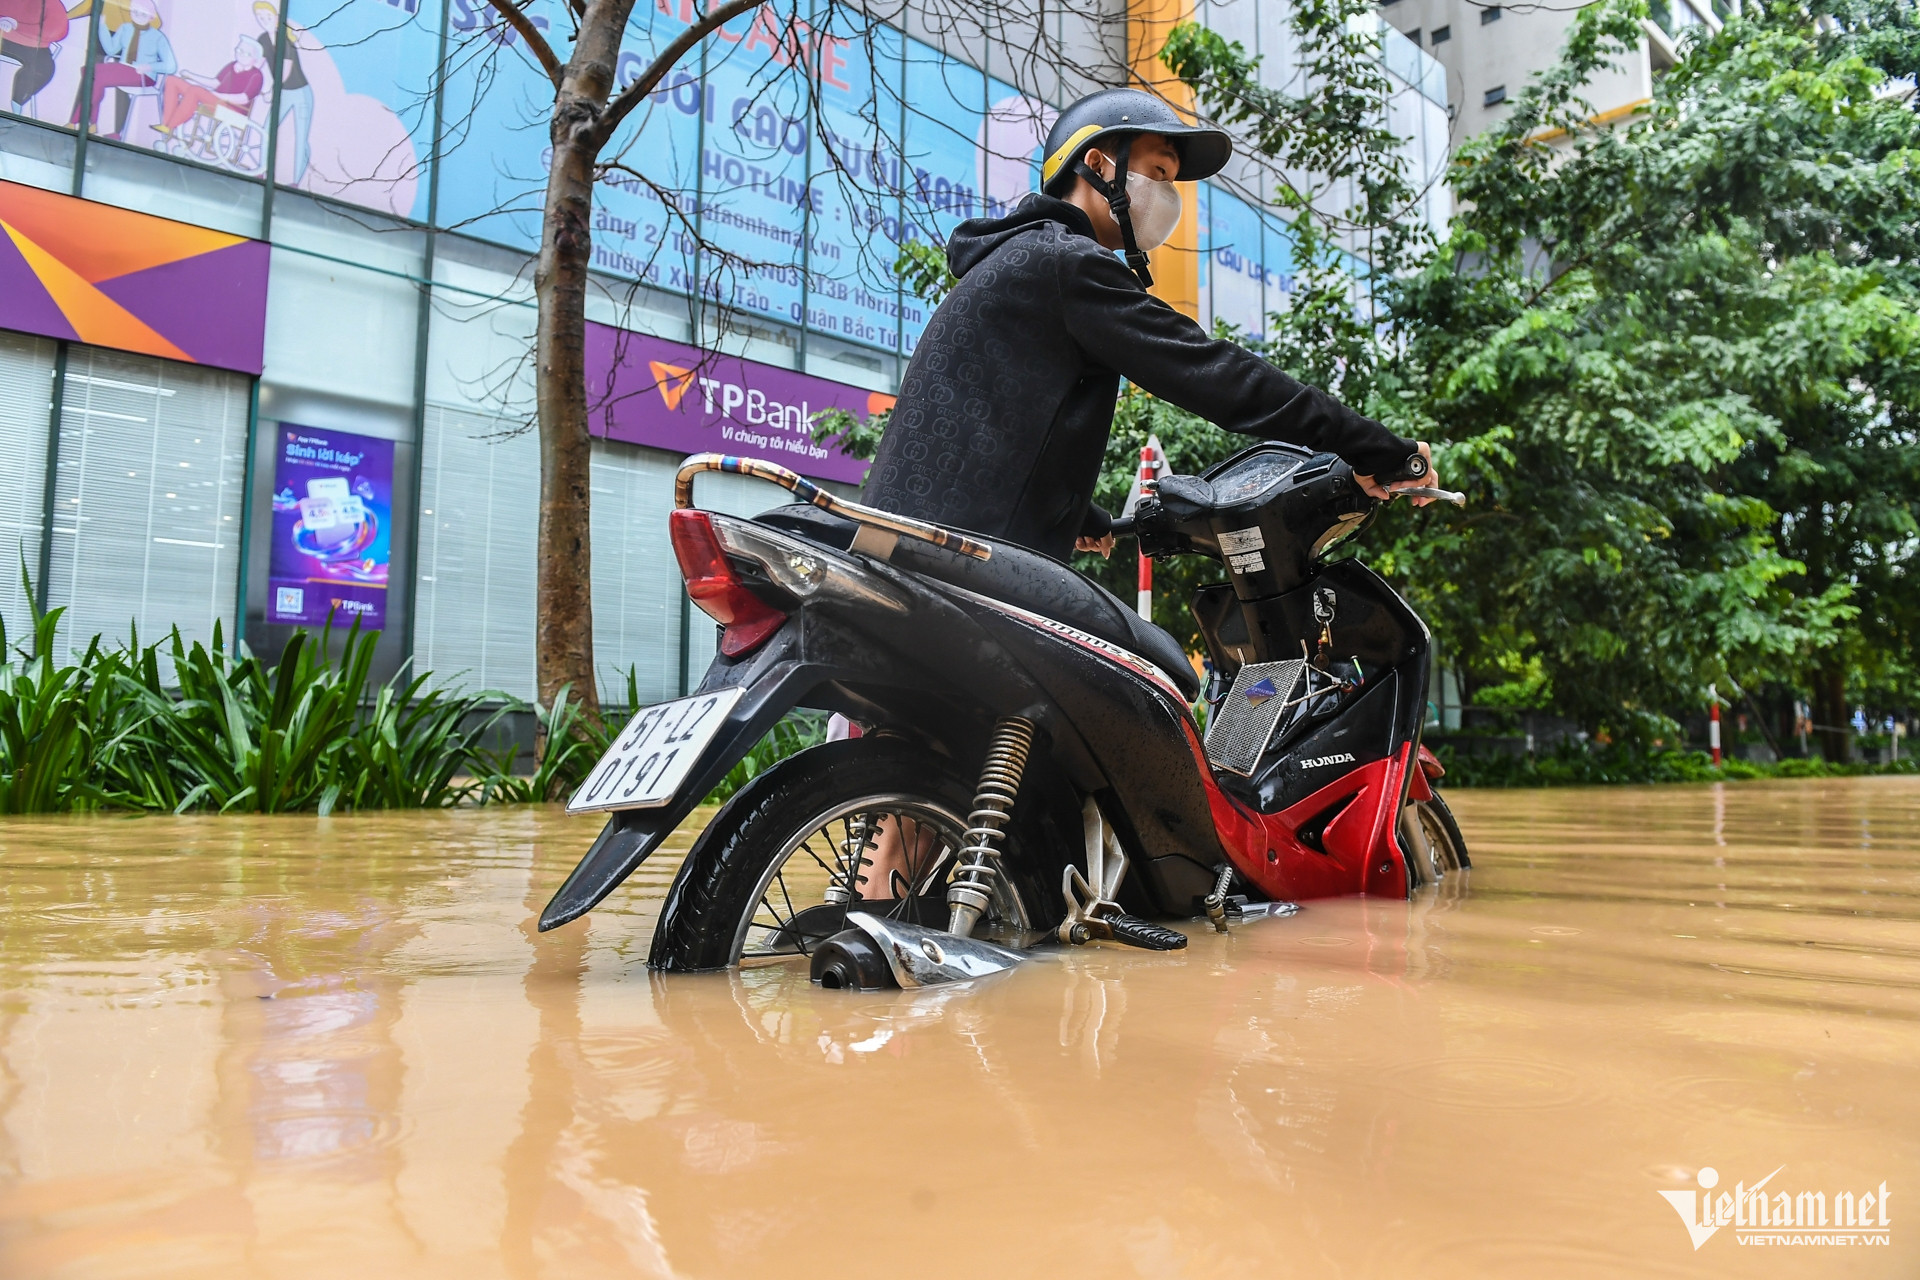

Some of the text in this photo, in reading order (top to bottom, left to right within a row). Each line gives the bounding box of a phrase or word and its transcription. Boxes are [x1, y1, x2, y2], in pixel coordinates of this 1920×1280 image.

[732, 97, 807, 155] CAO
[915, 166, 973, 218] BAN
[703, 150, 824, 216] HOTLINE
[1012, 240, 1039, 251] GUCCI
[591, 244, 660, 283] hường
[735, 281, 770, 311] Tảo
[790, 301, 838, 332] Quận
[843, 314, 875, 341] Bắc
[854, 287, 922, 324] Horizon
[930, 341, 957, 355] GUCCI
[932, 372, 962, 391] GUCCI
[699, 376, 817, 434] TPBank
[907, 398, 932, 411] GUCCI
[936, 405, 968, 425] GUCCI
[734, 429, 768, 449] chúng
[769, 434, 784, 448] tôi
[785, 437, 808, 455] hiểu
[808, 444, 828, 461] bạn
[908, 429, 936, 445] GUCCI
[286, 443, 316, 459] Sinh
[911, 462, 941, 481] GUCCI
[882, 485, 909, 501] GUCCI
[1301, 752, 1356, 770] HONDA
[585, 748, 680, 802] 0191
